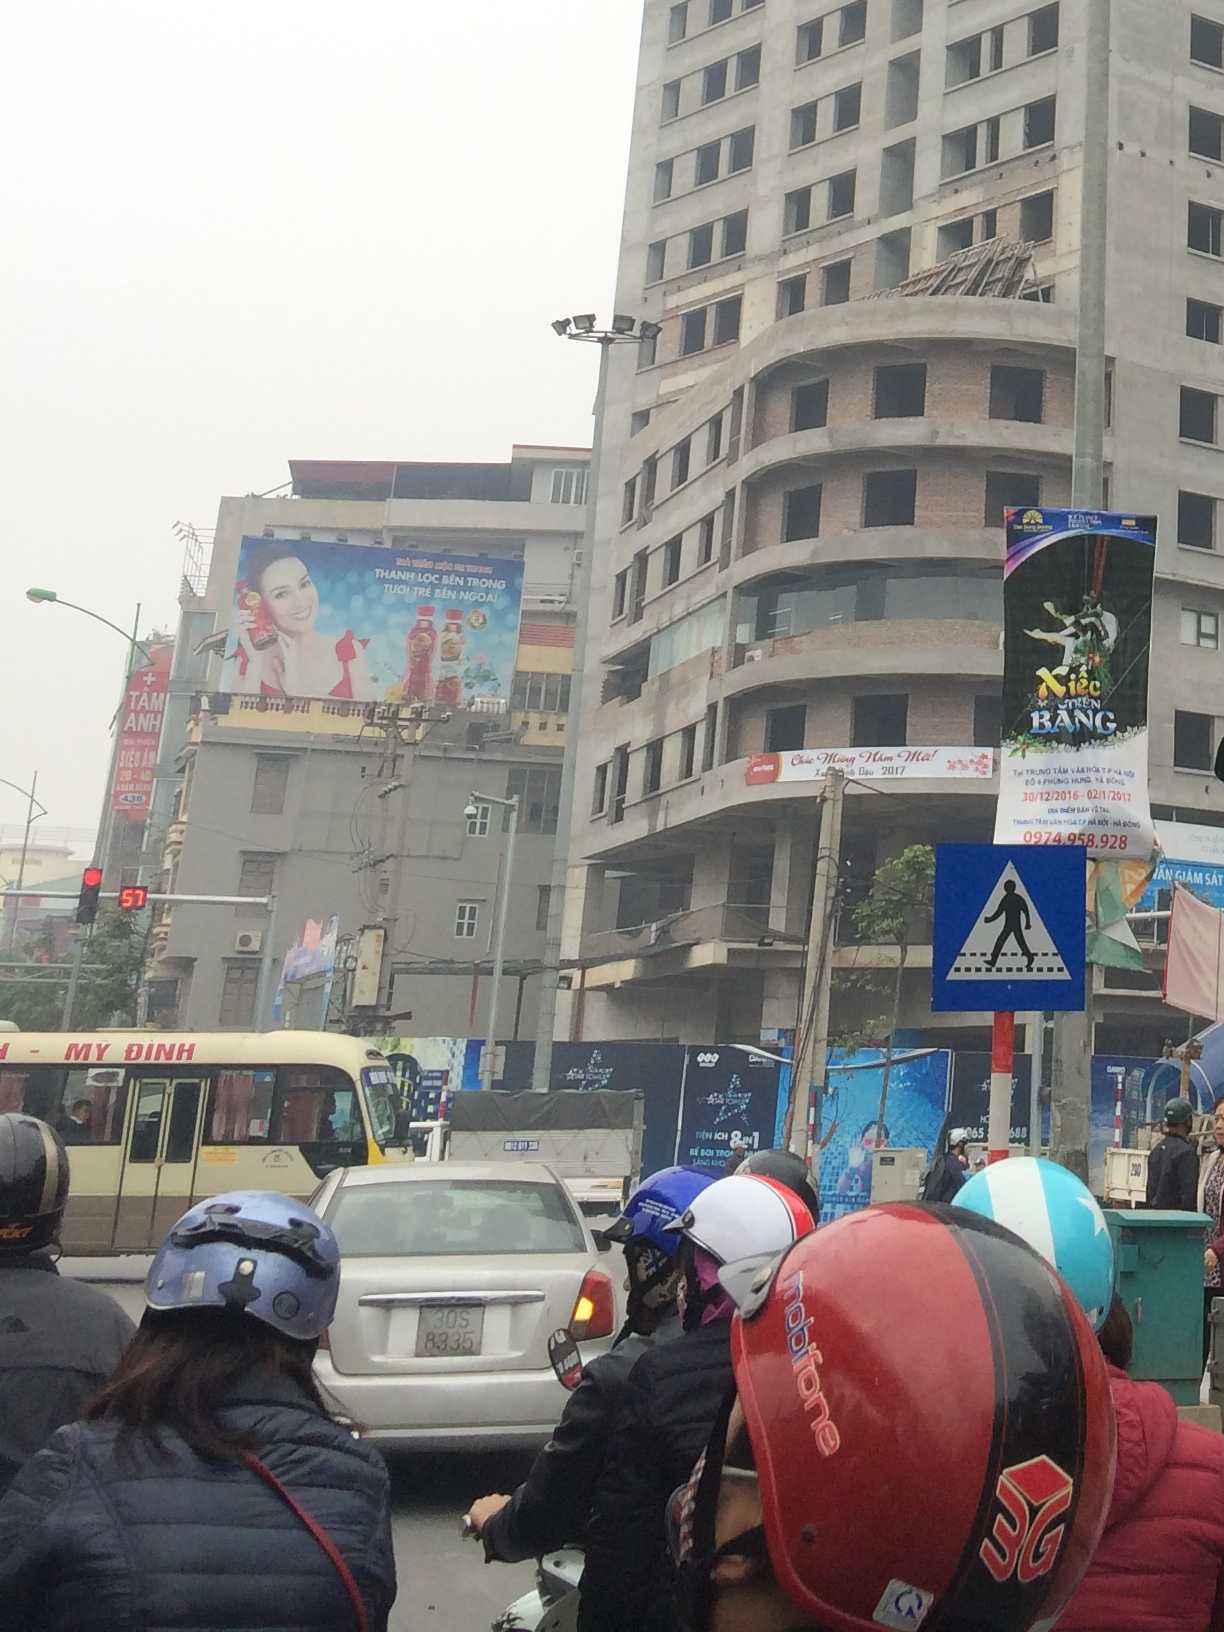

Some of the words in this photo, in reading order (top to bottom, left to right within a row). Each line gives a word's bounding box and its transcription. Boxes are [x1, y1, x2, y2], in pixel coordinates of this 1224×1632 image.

[124, 712, 161, 732] ANH
[881, 766, 906, 775] 2017
[121, 889, 145, 907] 57
[783, 1270, 841, 1456] mobifone
[979, 1468, 1073, 1582] 3G
